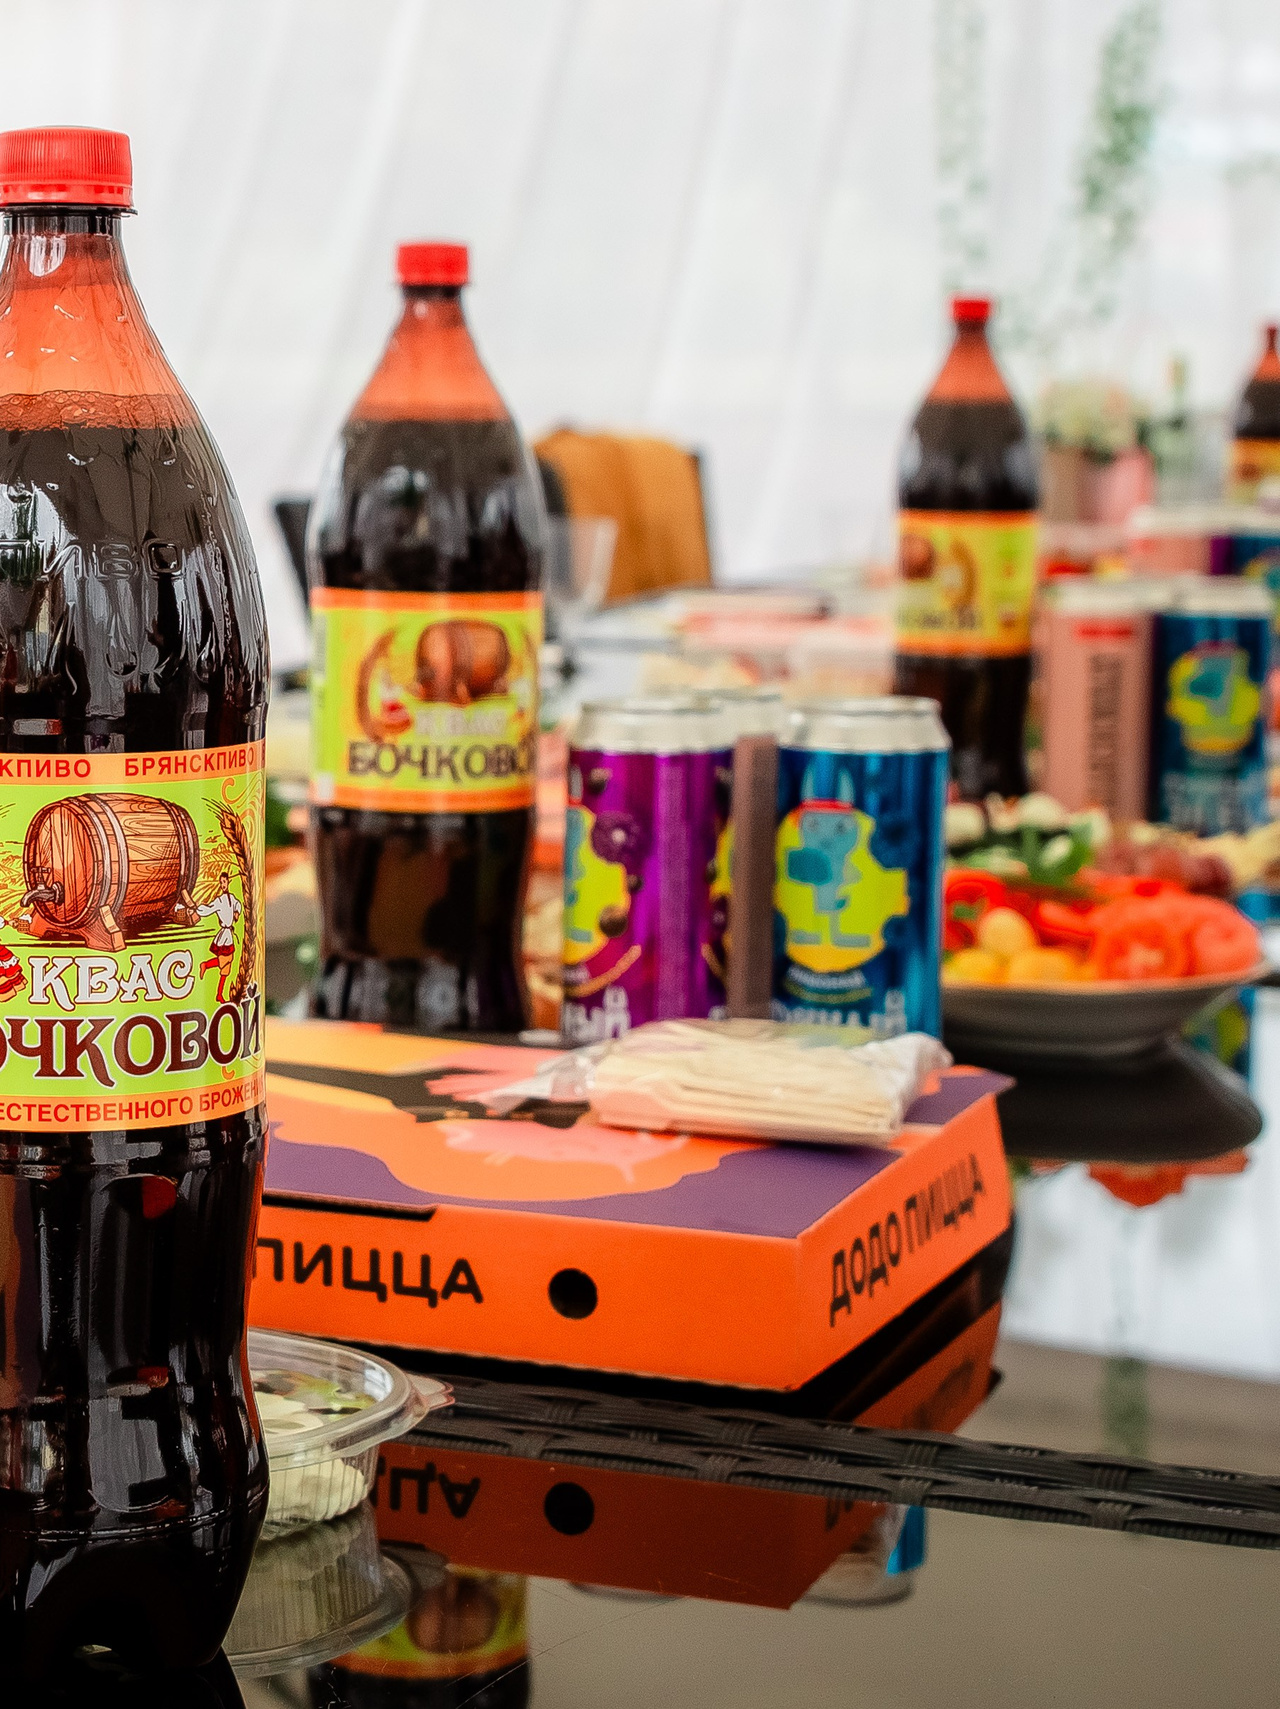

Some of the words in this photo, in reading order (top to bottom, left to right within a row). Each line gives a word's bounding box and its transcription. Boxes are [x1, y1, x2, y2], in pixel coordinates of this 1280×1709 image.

[124, 747, 254, 777] БРЯНСКПИВО
[28, 950, 196, 1012] КВАС
[253, 1237, 484, 1309] ПИЦЦА
